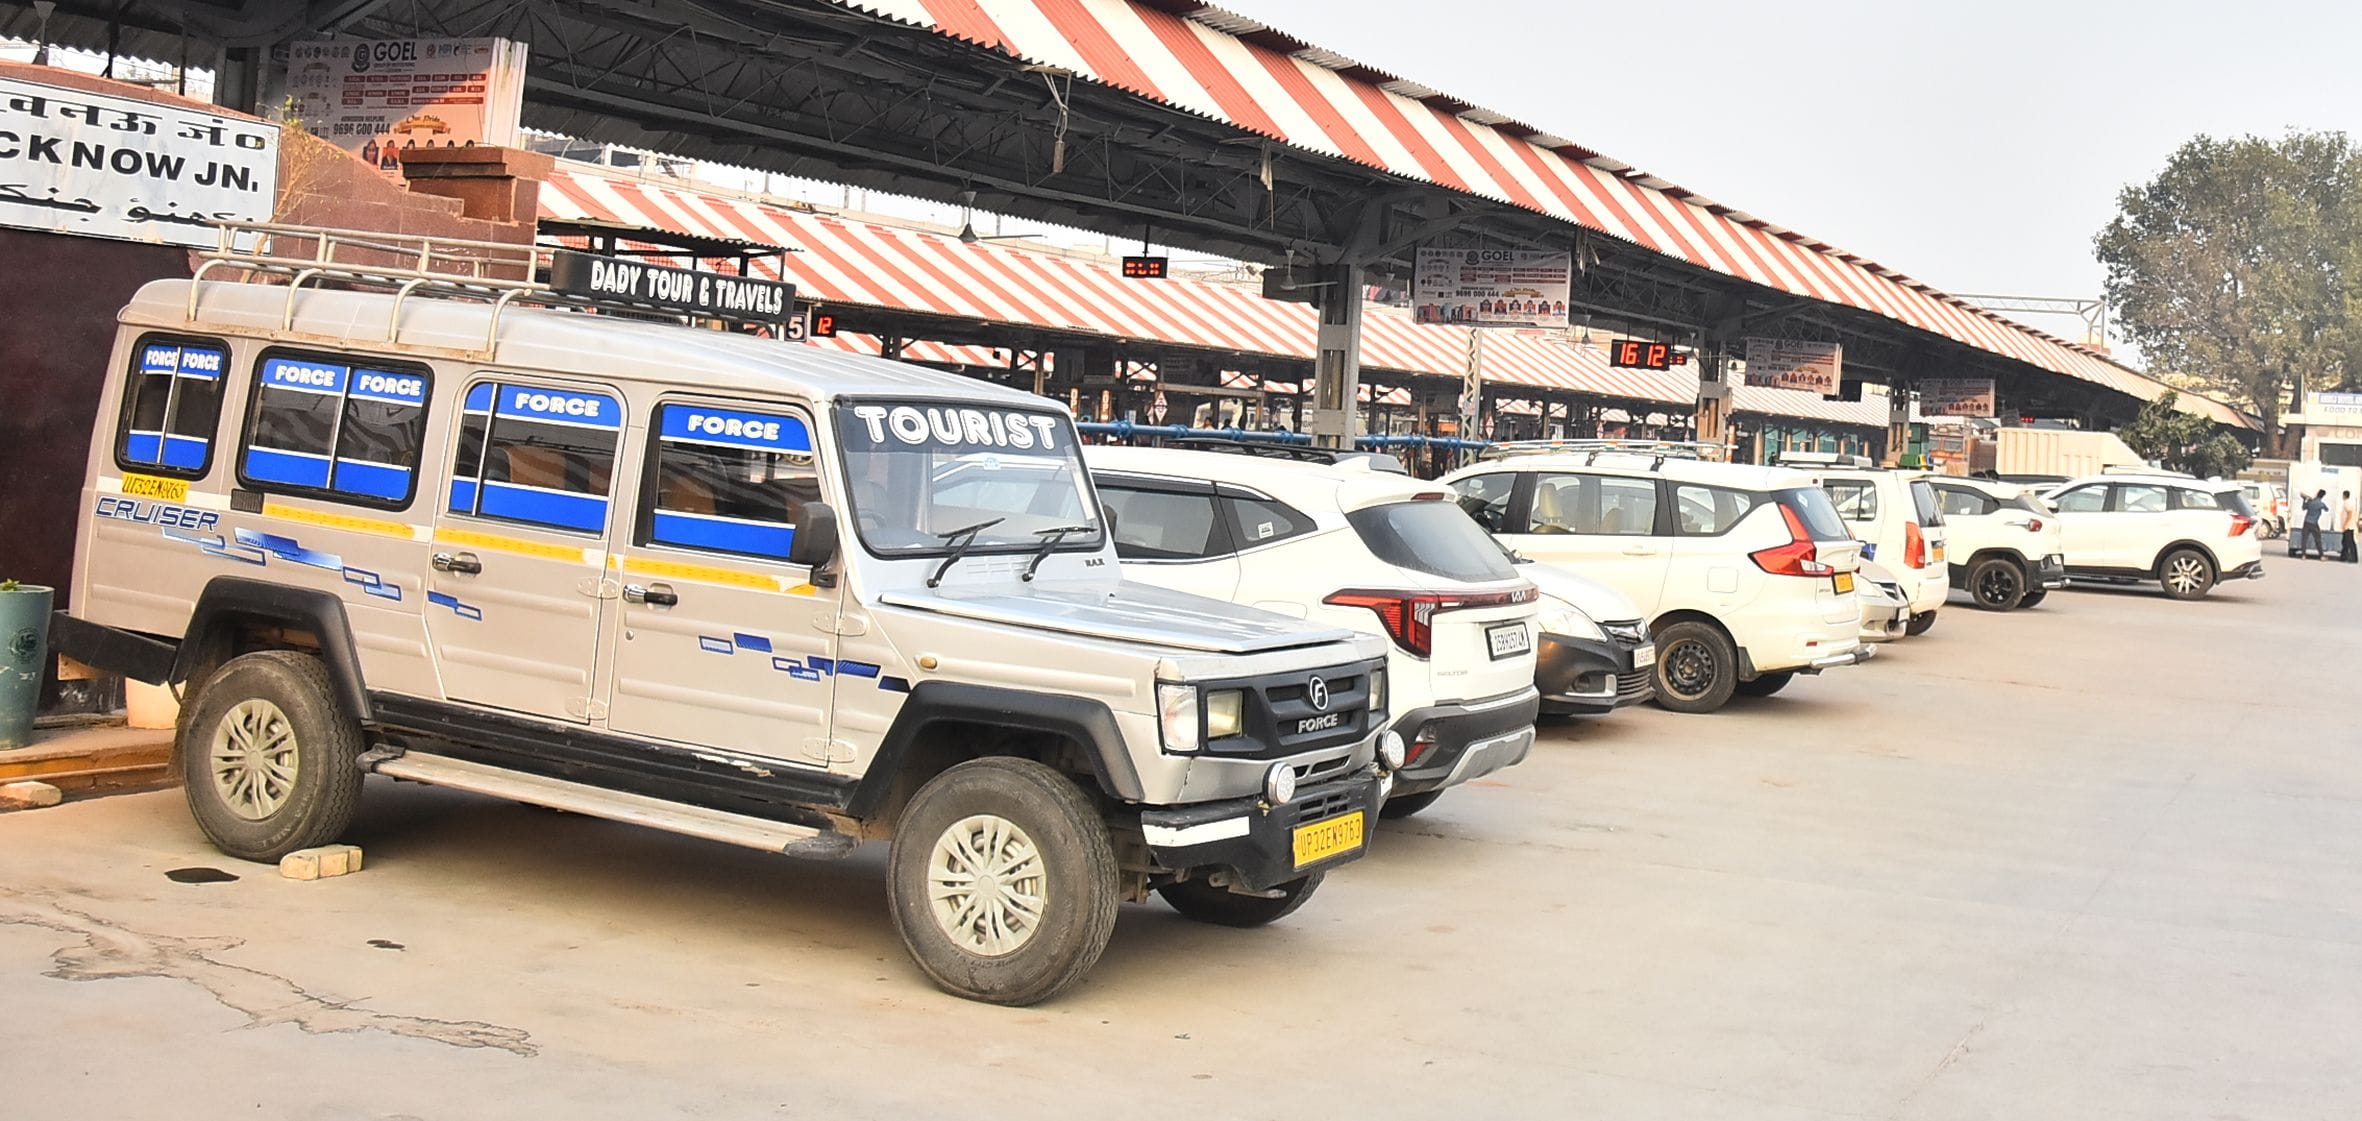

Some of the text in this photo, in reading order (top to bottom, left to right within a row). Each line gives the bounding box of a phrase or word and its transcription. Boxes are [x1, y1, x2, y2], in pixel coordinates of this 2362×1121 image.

[373, 41, 418, 62] GOEL
[1481, 250, 1515, 262] GOEL
[590, 259, 784, 315] DADY TOUR & TRAVELS
[787, 316, 804, 339] 5
[817, 316, 833, 335] 12
[145, 350, 220, 371] FORCE FORCE
[274, 364, 422, 397] FORCE FORCE
[515, 392, 601, 418] FORCE
[687, 414, 780, 441] FORCE
[853, 405, 1056, 450] TOURIST
[95, 497, 220, 533] CRUISER
[1297, 713, 1339, 734] FORCE
[1300, 819, 1361, 857] UP32EN9763
